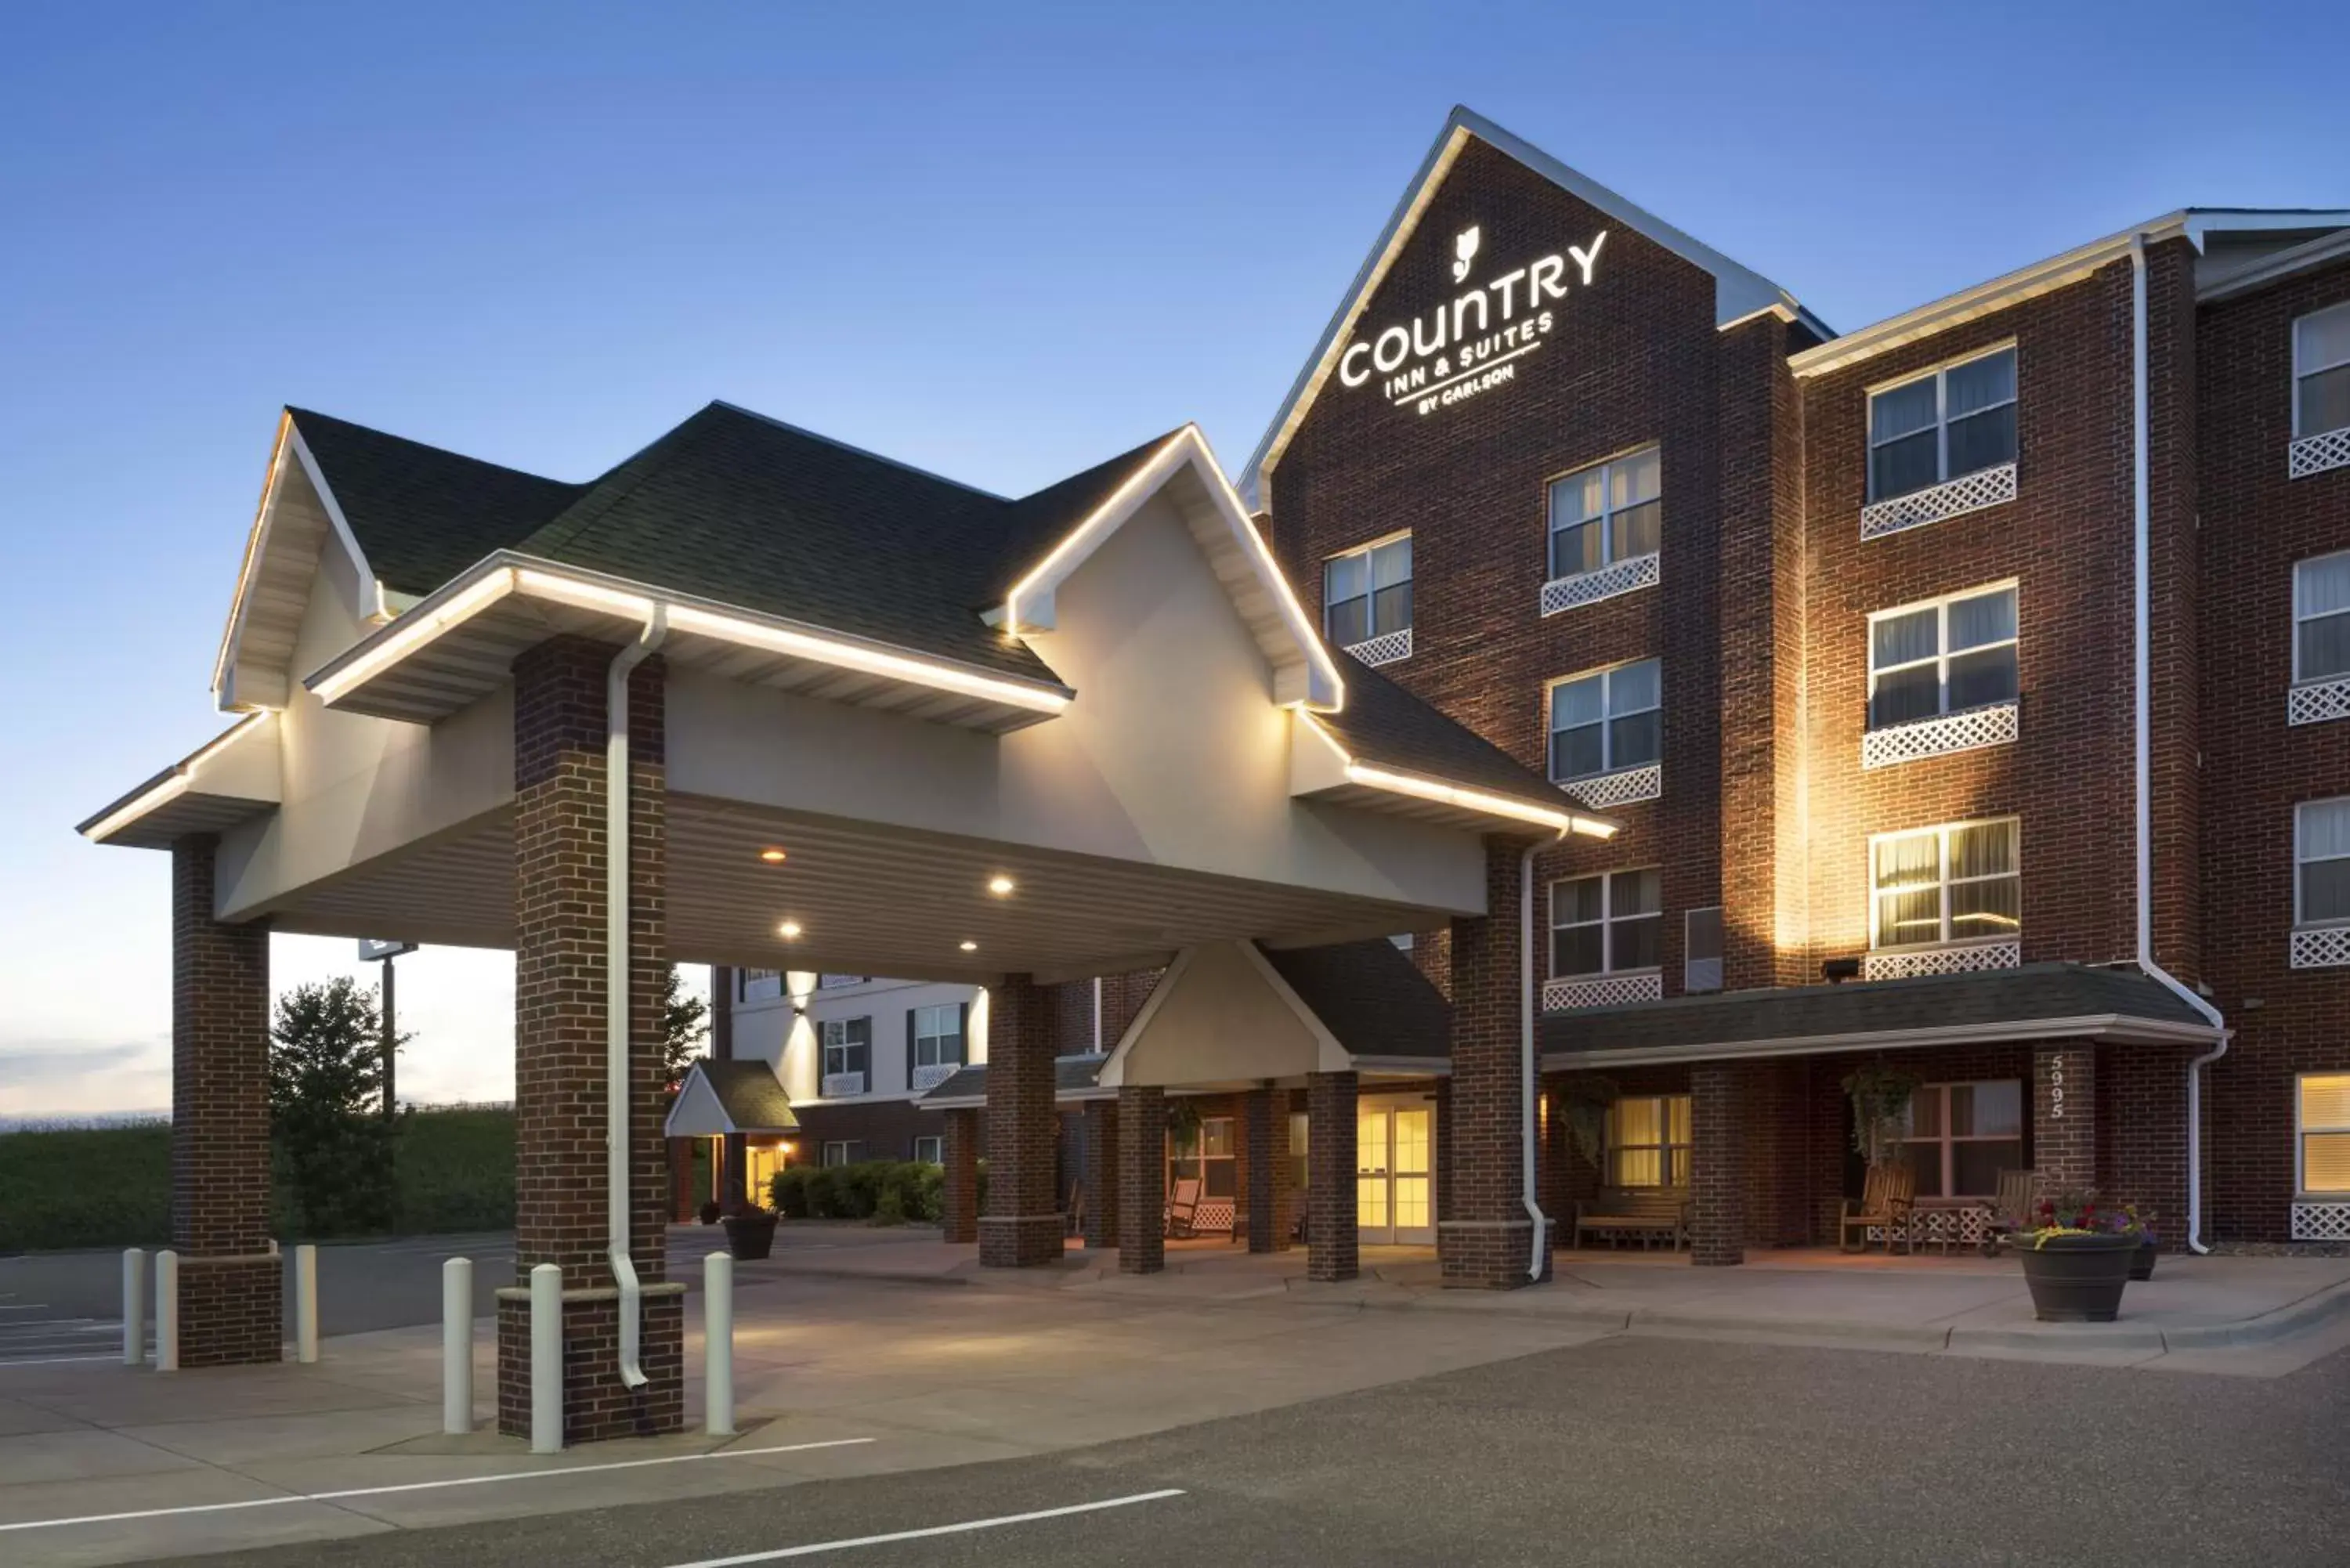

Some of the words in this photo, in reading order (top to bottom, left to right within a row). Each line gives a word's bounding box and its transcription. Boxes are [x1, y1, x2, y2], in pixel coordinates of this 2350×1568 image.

[1385, 367, 1425, 399] INN
[1434, 357, 1450, 377] &
[1459, 312, 1553, 367] SUITES
[1419, 396, 1438, 415] BY
[1441, 365, 1514, 405] CARLSON
[2051, 1055, 2063, 1119] 5995
